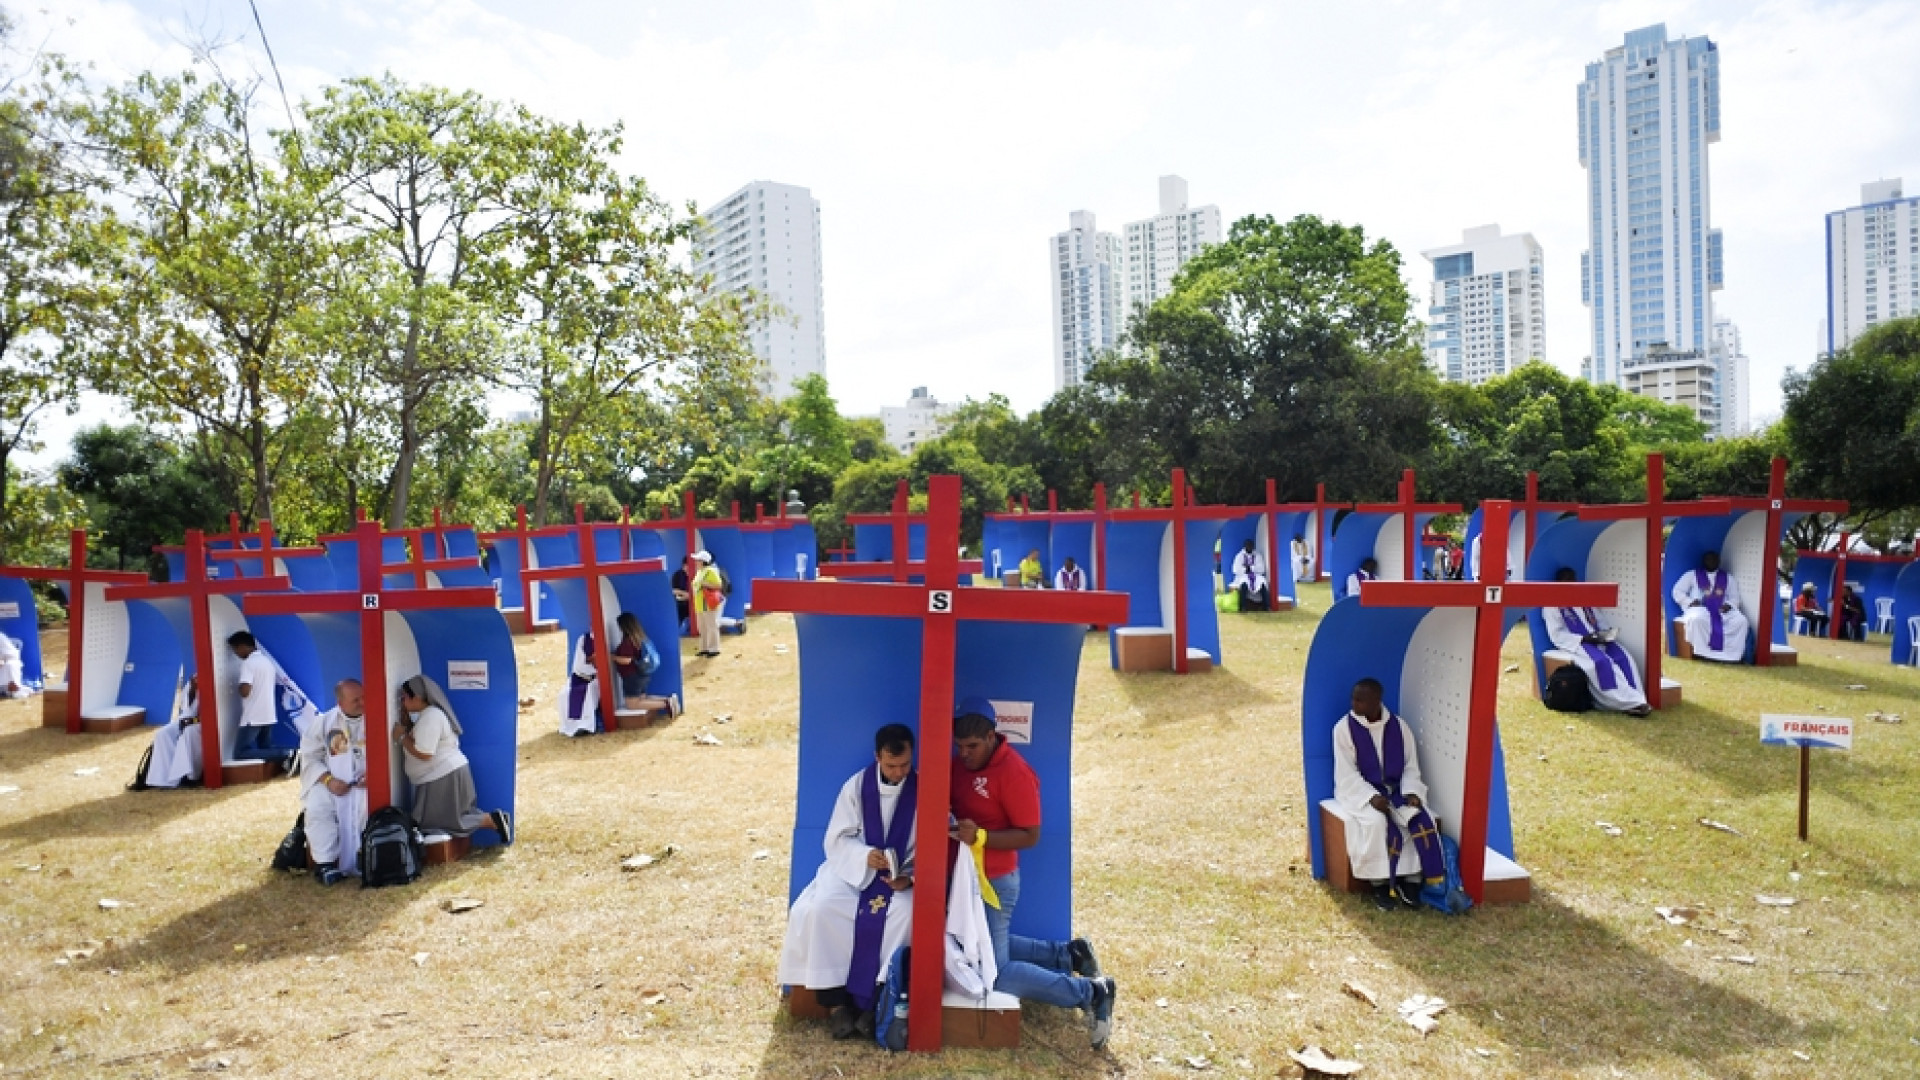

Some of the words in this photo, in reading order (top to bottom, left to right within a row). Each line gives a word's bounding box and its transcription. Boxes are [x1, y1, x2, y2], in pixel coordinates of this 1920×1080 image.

[933, 592, 948, 610] S
[1488, 587, 1499, 601] T
[1784, 721, 1849, 736] FRANÇAIS
